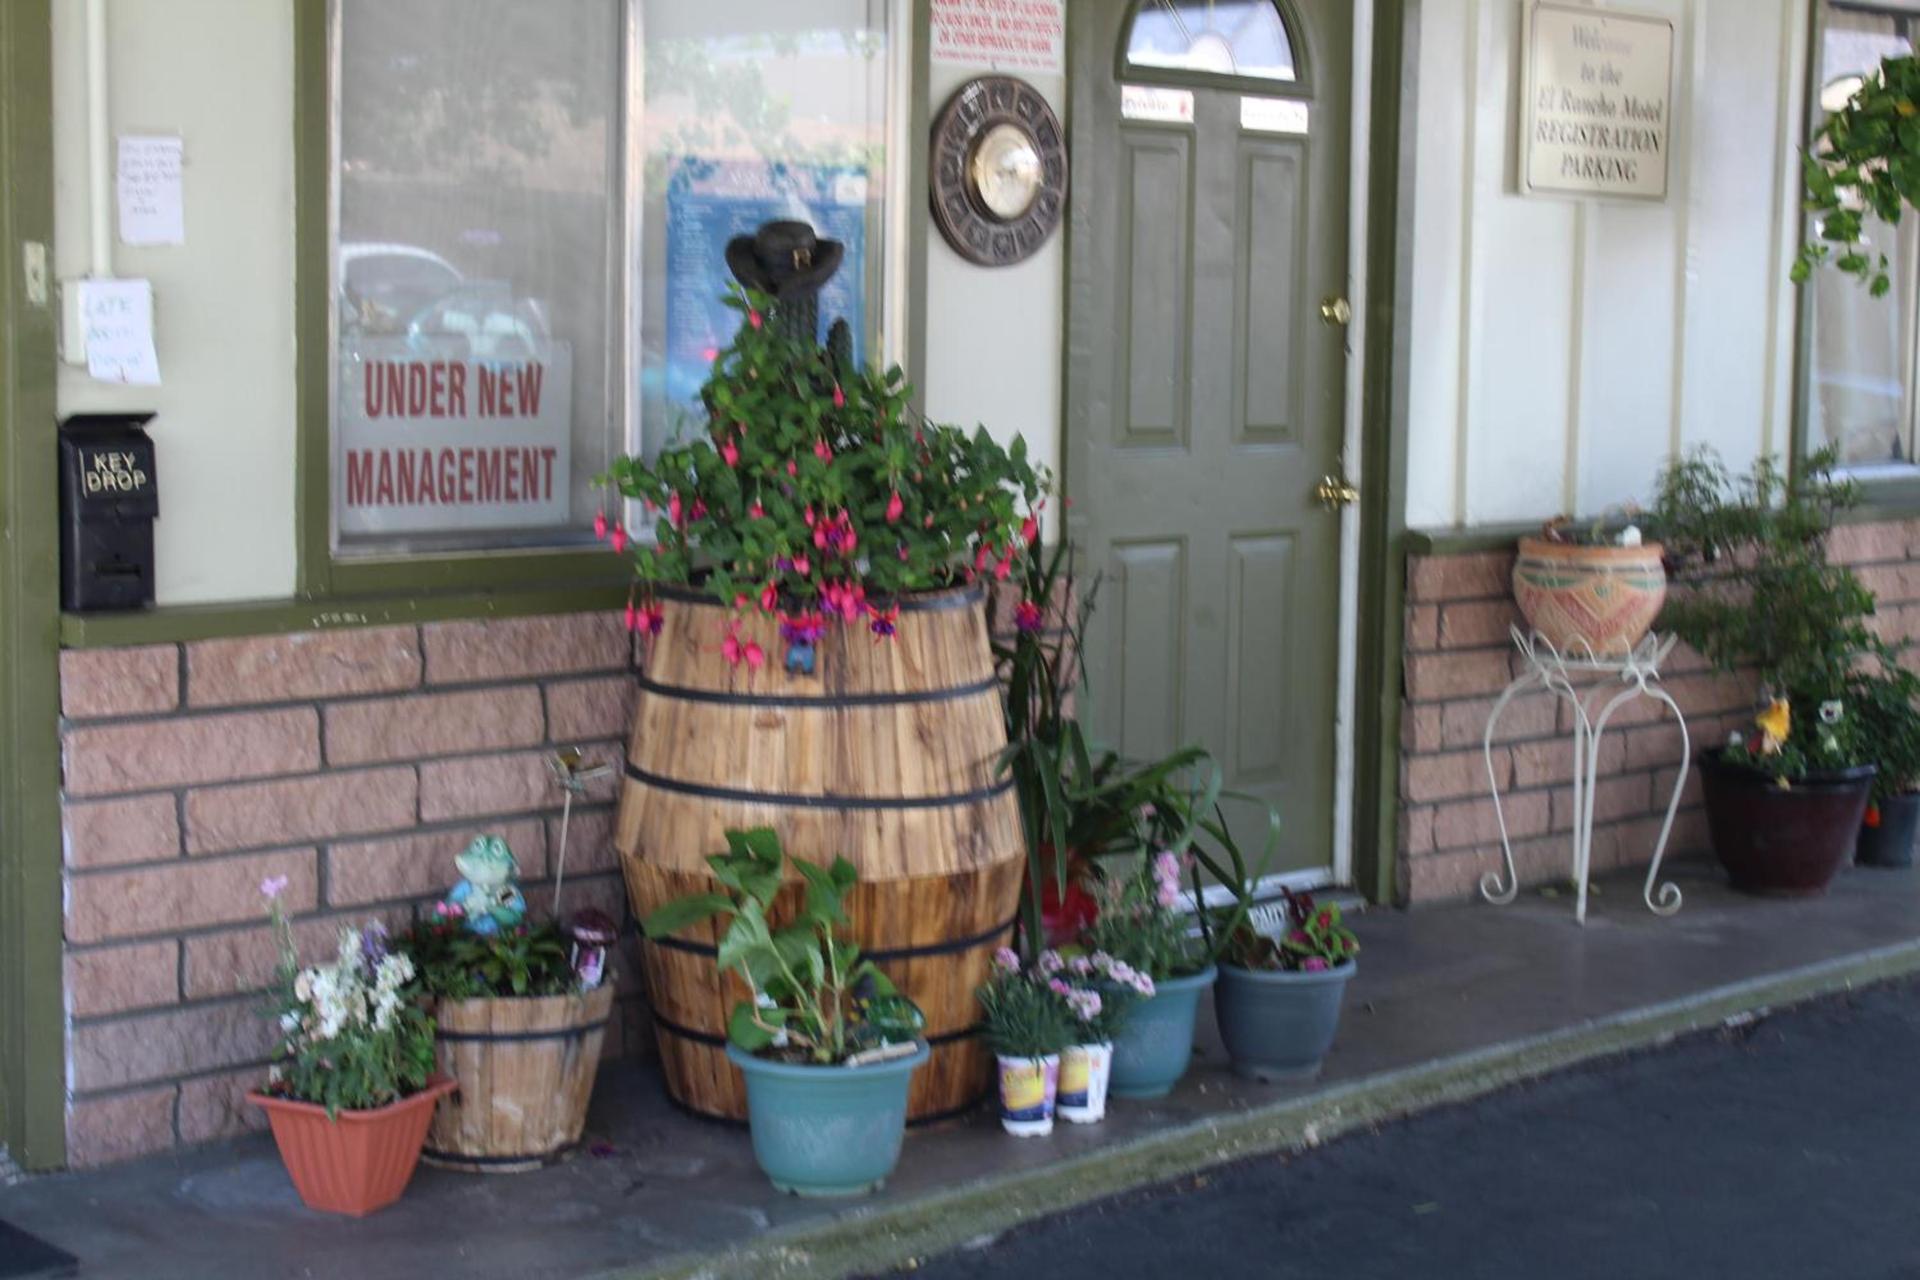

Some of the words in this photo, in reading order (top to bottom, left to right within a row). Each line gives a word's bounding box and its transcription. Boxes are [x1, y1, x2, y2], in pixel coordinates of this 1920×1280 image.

[1581, 61, 1595, 84] to
[1600, 59, 1623, 86] the
[1561, 87, 1616, 119] Rancho
[1622, 94, 1663, 123] Motel
[1536, 119, 1663, 153] REGISTRATION
[1561, 151, 1638, 183] PARKING
[364, 360, 467, 419] UNDER
[477, 361, 544, 419] NEW
[92, 450, 136, 473] KEY
[347, 446, 557, 507] MANAGEMENT
[86, 469, 147, 492] DROP
